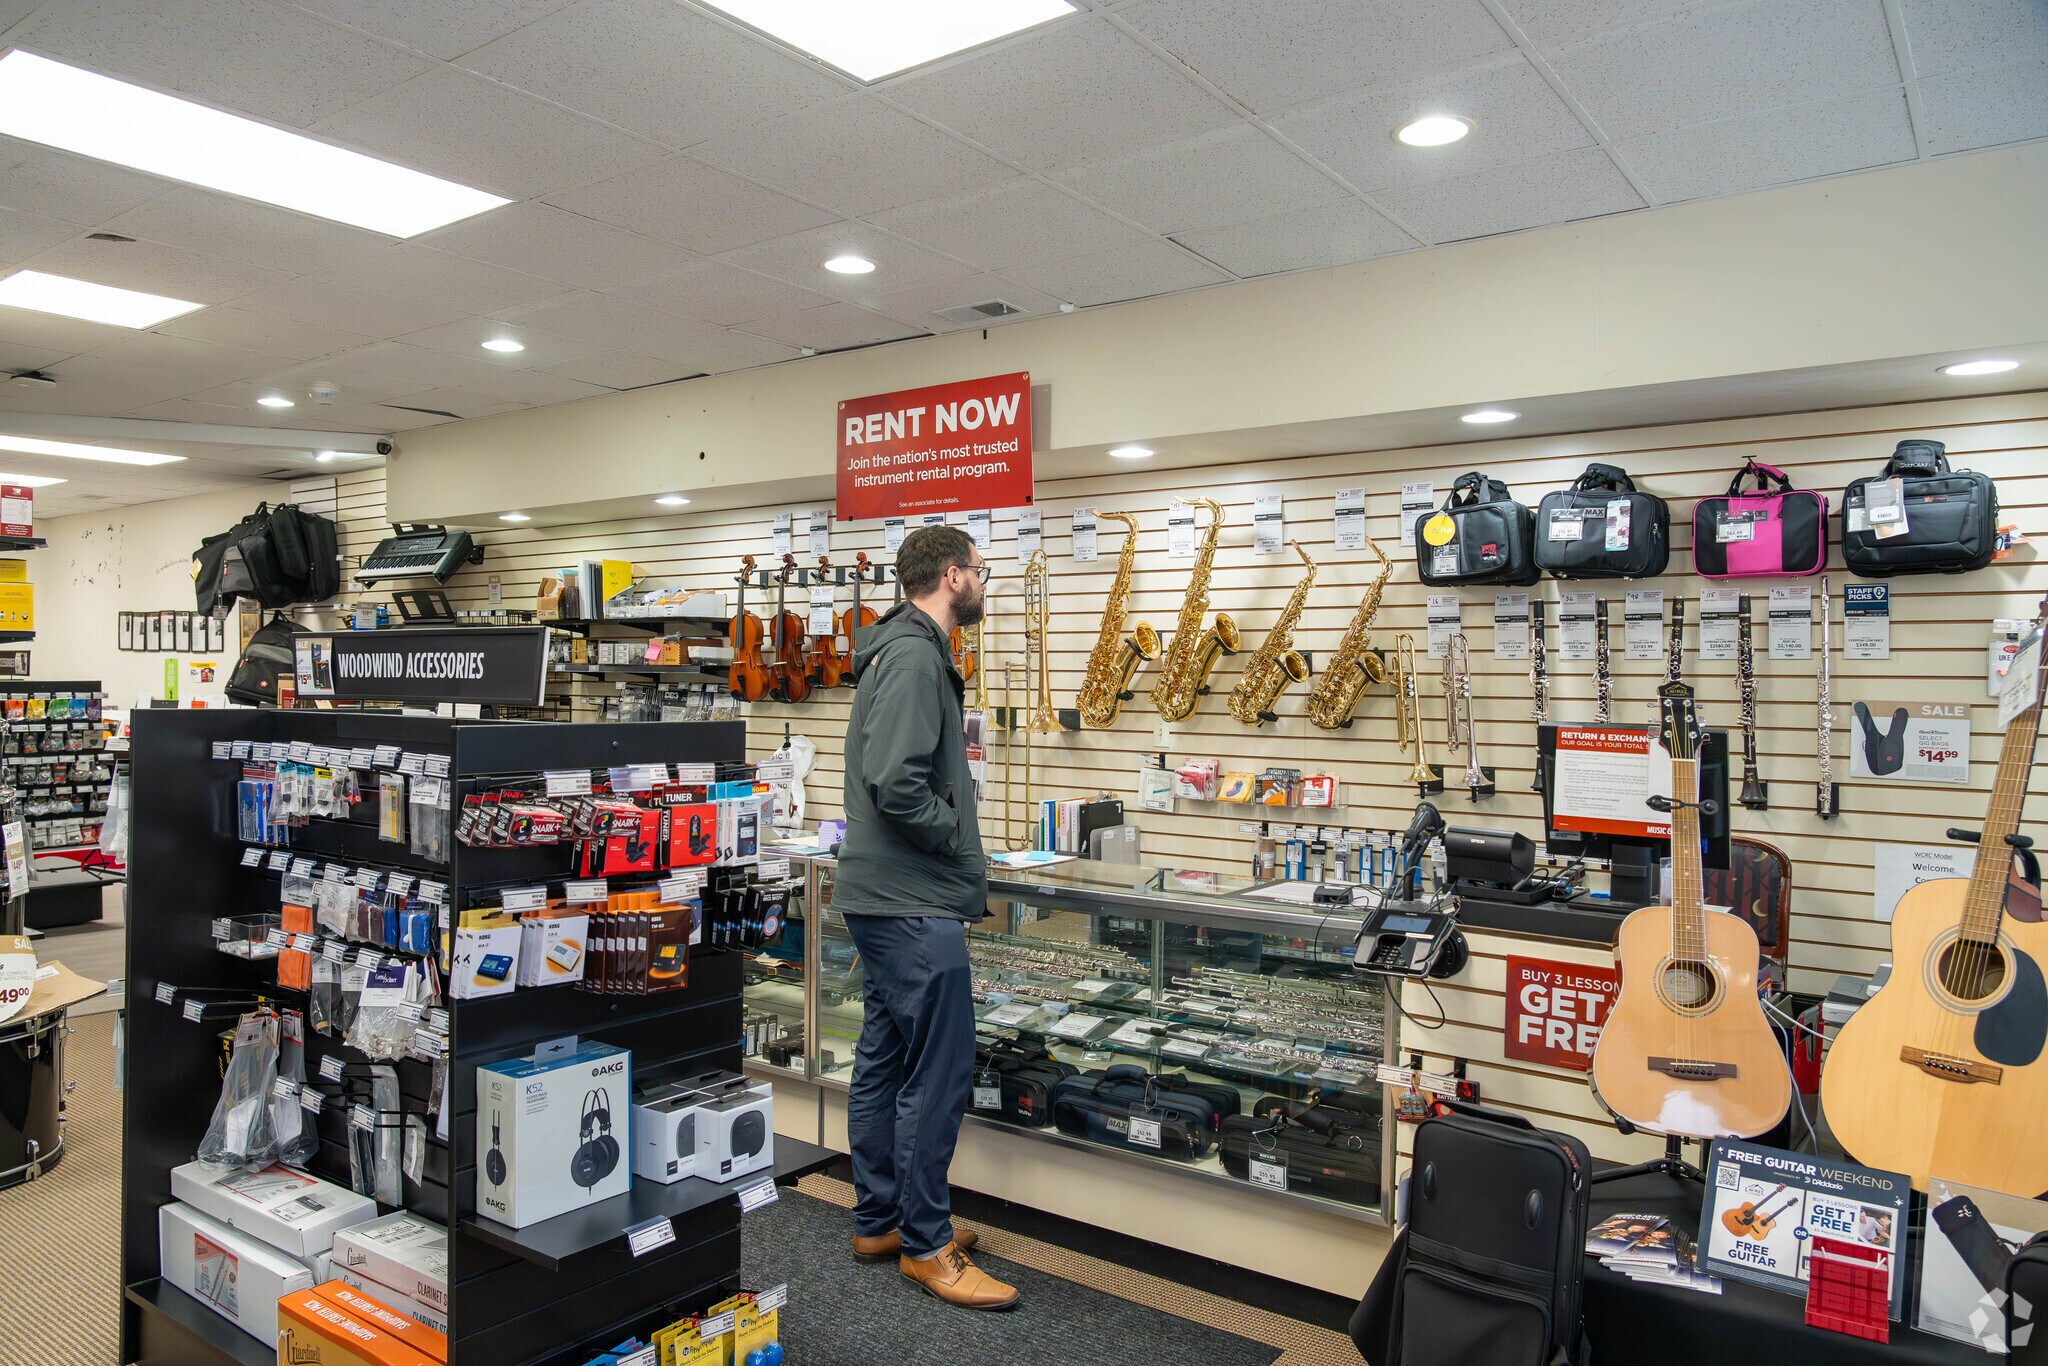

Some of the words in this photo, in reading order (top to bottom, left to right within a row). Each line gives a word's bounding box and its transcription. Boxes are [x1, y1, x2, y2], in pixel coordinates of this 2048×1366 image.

[845, 407, 925, 446] RENT
[935, 392, 1021, 434] NOW
[847, 457, 870, 471] Join
[872, 453, 890, 466] the
[893, 449, 937, 466] nation's
[940, 445, 971, 460] most
[973, 438, 1018, 456] trusted
[854, 468, 914, 487] instrument
[916, 465, 950, 481] rental
[953, 461, 1010, 480] program.
[914, 499, 935, 507] associate
[1585, 508, 1604, 516] MAX
[338, 653, 403, 678] WOODWIND
[406, 652, 485, 680] ACCESSORIES
[1921, 705, 1965, 717] SALE
[1561, 731, 1598, 741] RETURN
[665, 794, 693, 803] TUNER
[532, 824, 561, 834] SNARK+
[612, 819, 641, 829] SNARK+
[1647, 826, 1667, 834] MUSIC
[1934, 853, 1953, 861] Model
[1912, 863, 1955, 874] Welcome
[1522, 969, 1551, 983] BUY
[1554, 975, 1563, 985] 3
[1520, 984, 1605, 1023] GET
[599, 1062, 623, 1076] AKG
[526, 1082, 544, 1094] K52
[1437, 1094, 1461, 1102] BATTERY
[1109, 1119, 1127, 1129] MAX
[1259, 1171, 1276, 1180] $55.95
[1727, 1149, 1763, 1165] FREE
[1765, 1157, 1817, 1176] GUITAR
[1819, 1167, 1893, 1191] WEEKEND
[490, 1198, 506, 1211] AKG
[1831, 1201, 1858, 1210] LESSONS
[1813, 1205, 1845, 1218] GET
[1849, 1211, 1856, 1222] 1
[1810, 1216, 1852, 1234] FREE
[1795, 1229, 1808, 1237] OR
[1736, 1241, 1769, 1256] FREE
[1728, 1250, 1777, 1268] GUITAR
[335, 1290, 356, 1302] PACK
[418, 1281, 443, 1304] CLARINET
[303, 1300, 324, 1312] PACK
[350, 1297, 378, 1313] STARTER
[316, 1307, 346, 1324] STARTER
[374, 1309, 411, 1330] SAXOPHONE
[337, 1320, 378, 1341] SAXOPHONE
[287, 1328, 323, 1366] Giardinelli
